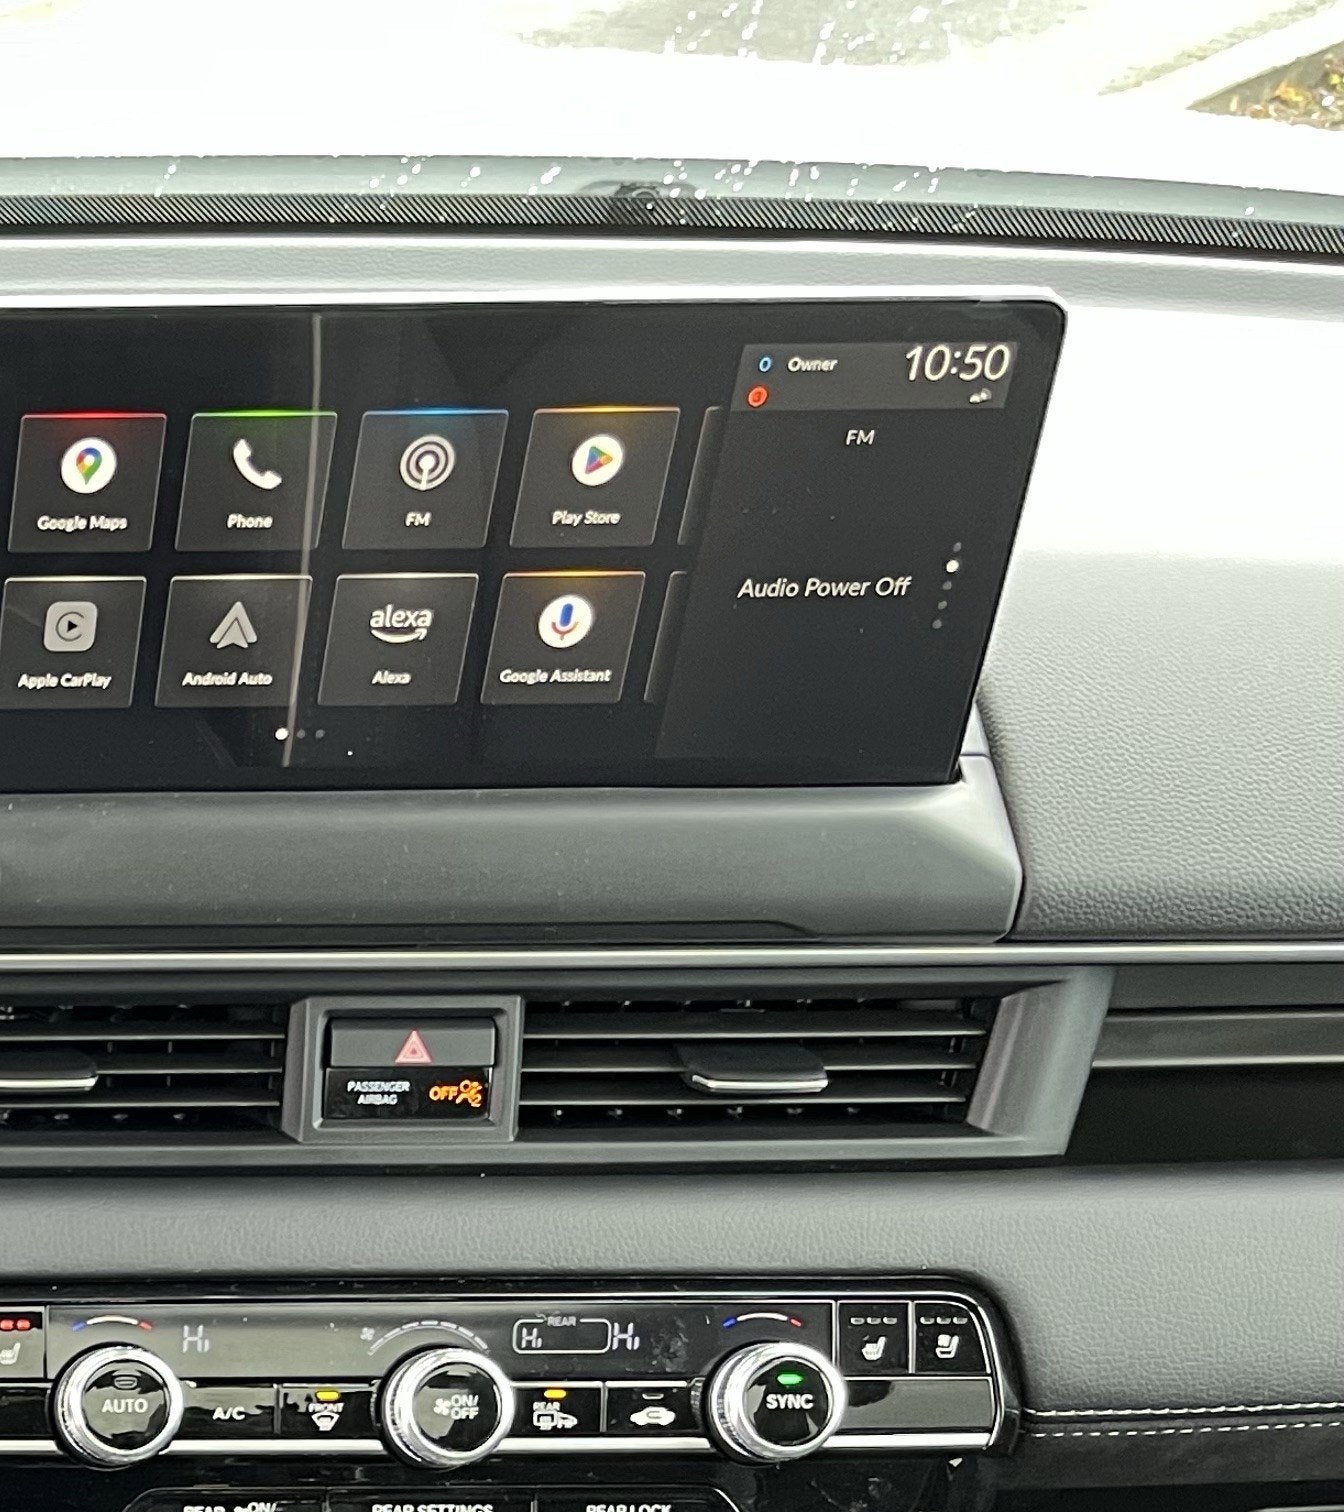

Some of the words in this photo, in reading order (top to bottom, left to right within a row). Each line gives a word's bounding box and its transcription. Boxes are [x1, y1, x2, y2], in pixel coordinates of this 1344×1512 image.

[787, 357, 838, 372] Owner
[905, 344, 1011, 381] 10:50
[845, 429, 875, 445] FM
[37, 514, 86, 533] Google
[89, 514, 127, 532] Maps
[227, 513, 273, 529] Phone
[405, 512, 430, 527] FM
[552, 511, 582, 527] Play
[583, 510, 620, 525] Store
[737, 577, 798, 599] Audio
[803, 578, 871, 598] Power
[875, 576, 911, 596] Off
[370, 604, 432, 631] alexa
[18, 672, 58, 689] Apple
[60, 672, 111, 689] CarPlay
[182, 671, 237, 686] Android
[238, 671, 273, 686] Auto
[372, 671, 410, 685] Alexa
[500, 669, 548, 686] Google
[549, 668, 611, 683] Assistant
[347, 1081, 410, 1092] PASSENGER
[429, 1086, 458, 1101] OFF
[357, 1094, 398, 1105] AIRBAG
[547, 1315, 576, 1326] REAR
[102, 1399, 148, 1414] AUTO
[310, 1403, 344, 1413] FRONT
[533, 1402, 561, 1412] REAR
[766, 1394, 814, 1410] SYNC
[213, 1406, 246, 1421] A/C
[451, 1407, 479, 1420] OFF
